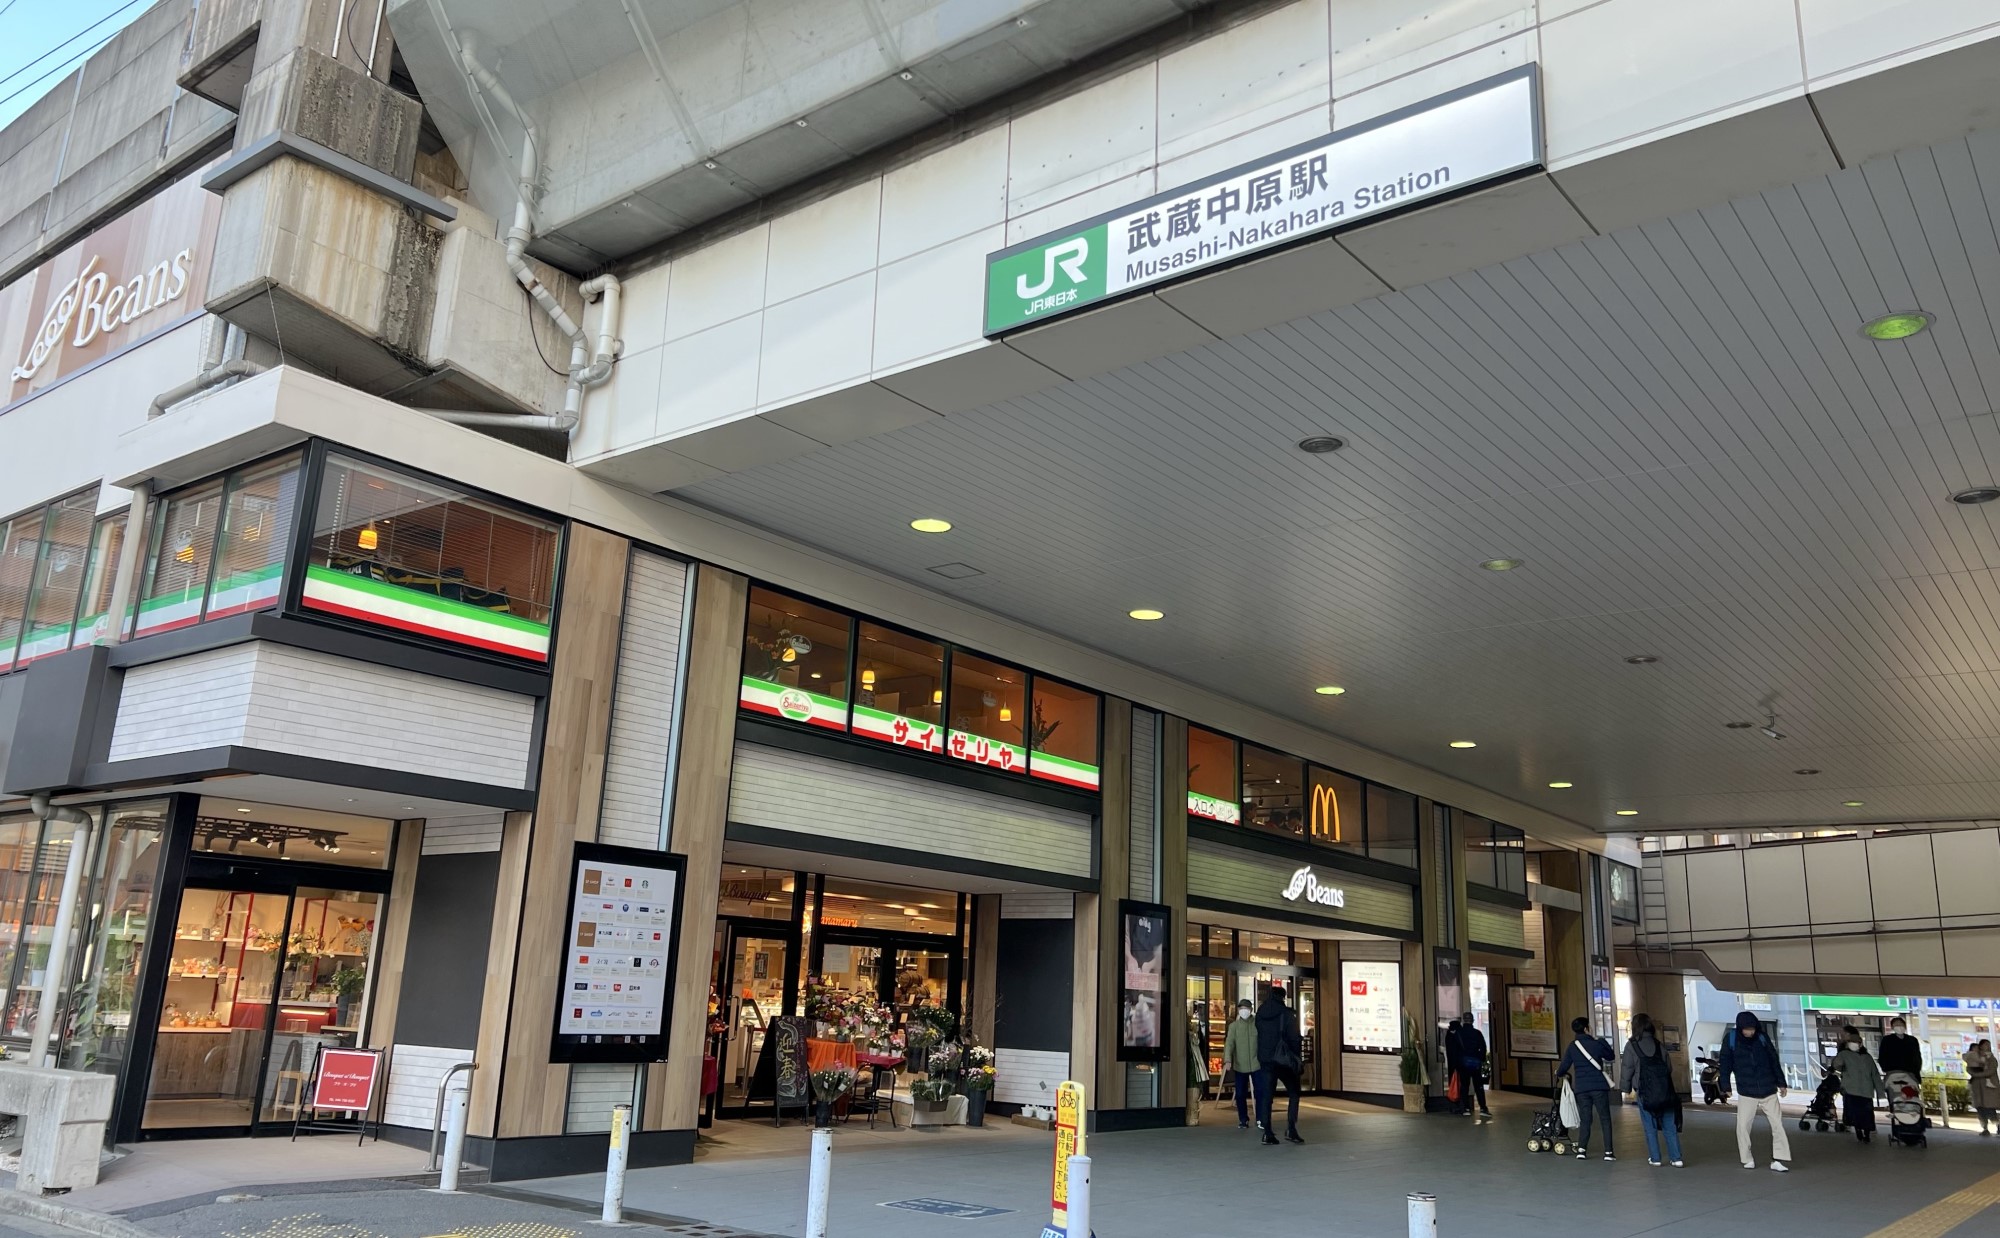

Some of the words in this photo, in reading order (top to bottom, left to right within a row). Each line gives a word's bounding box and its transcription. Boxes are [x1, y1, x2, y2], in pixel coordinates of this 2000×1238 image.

[1125, 201, 1345, 284] Musashi-Nakahara
[1354, 165, 1451, 209] Station
[1127, 153, 1329, 256] 武蔵中原駅
[73, 248, 192, 348] Beans
[1016, 236, 1089, 299] JR
[1024, 288, 1078, 316] JR東日本
[1306, 873, 1345, 908] Beans
[1055, 1128, 1066, 1199] 通行して下さい
